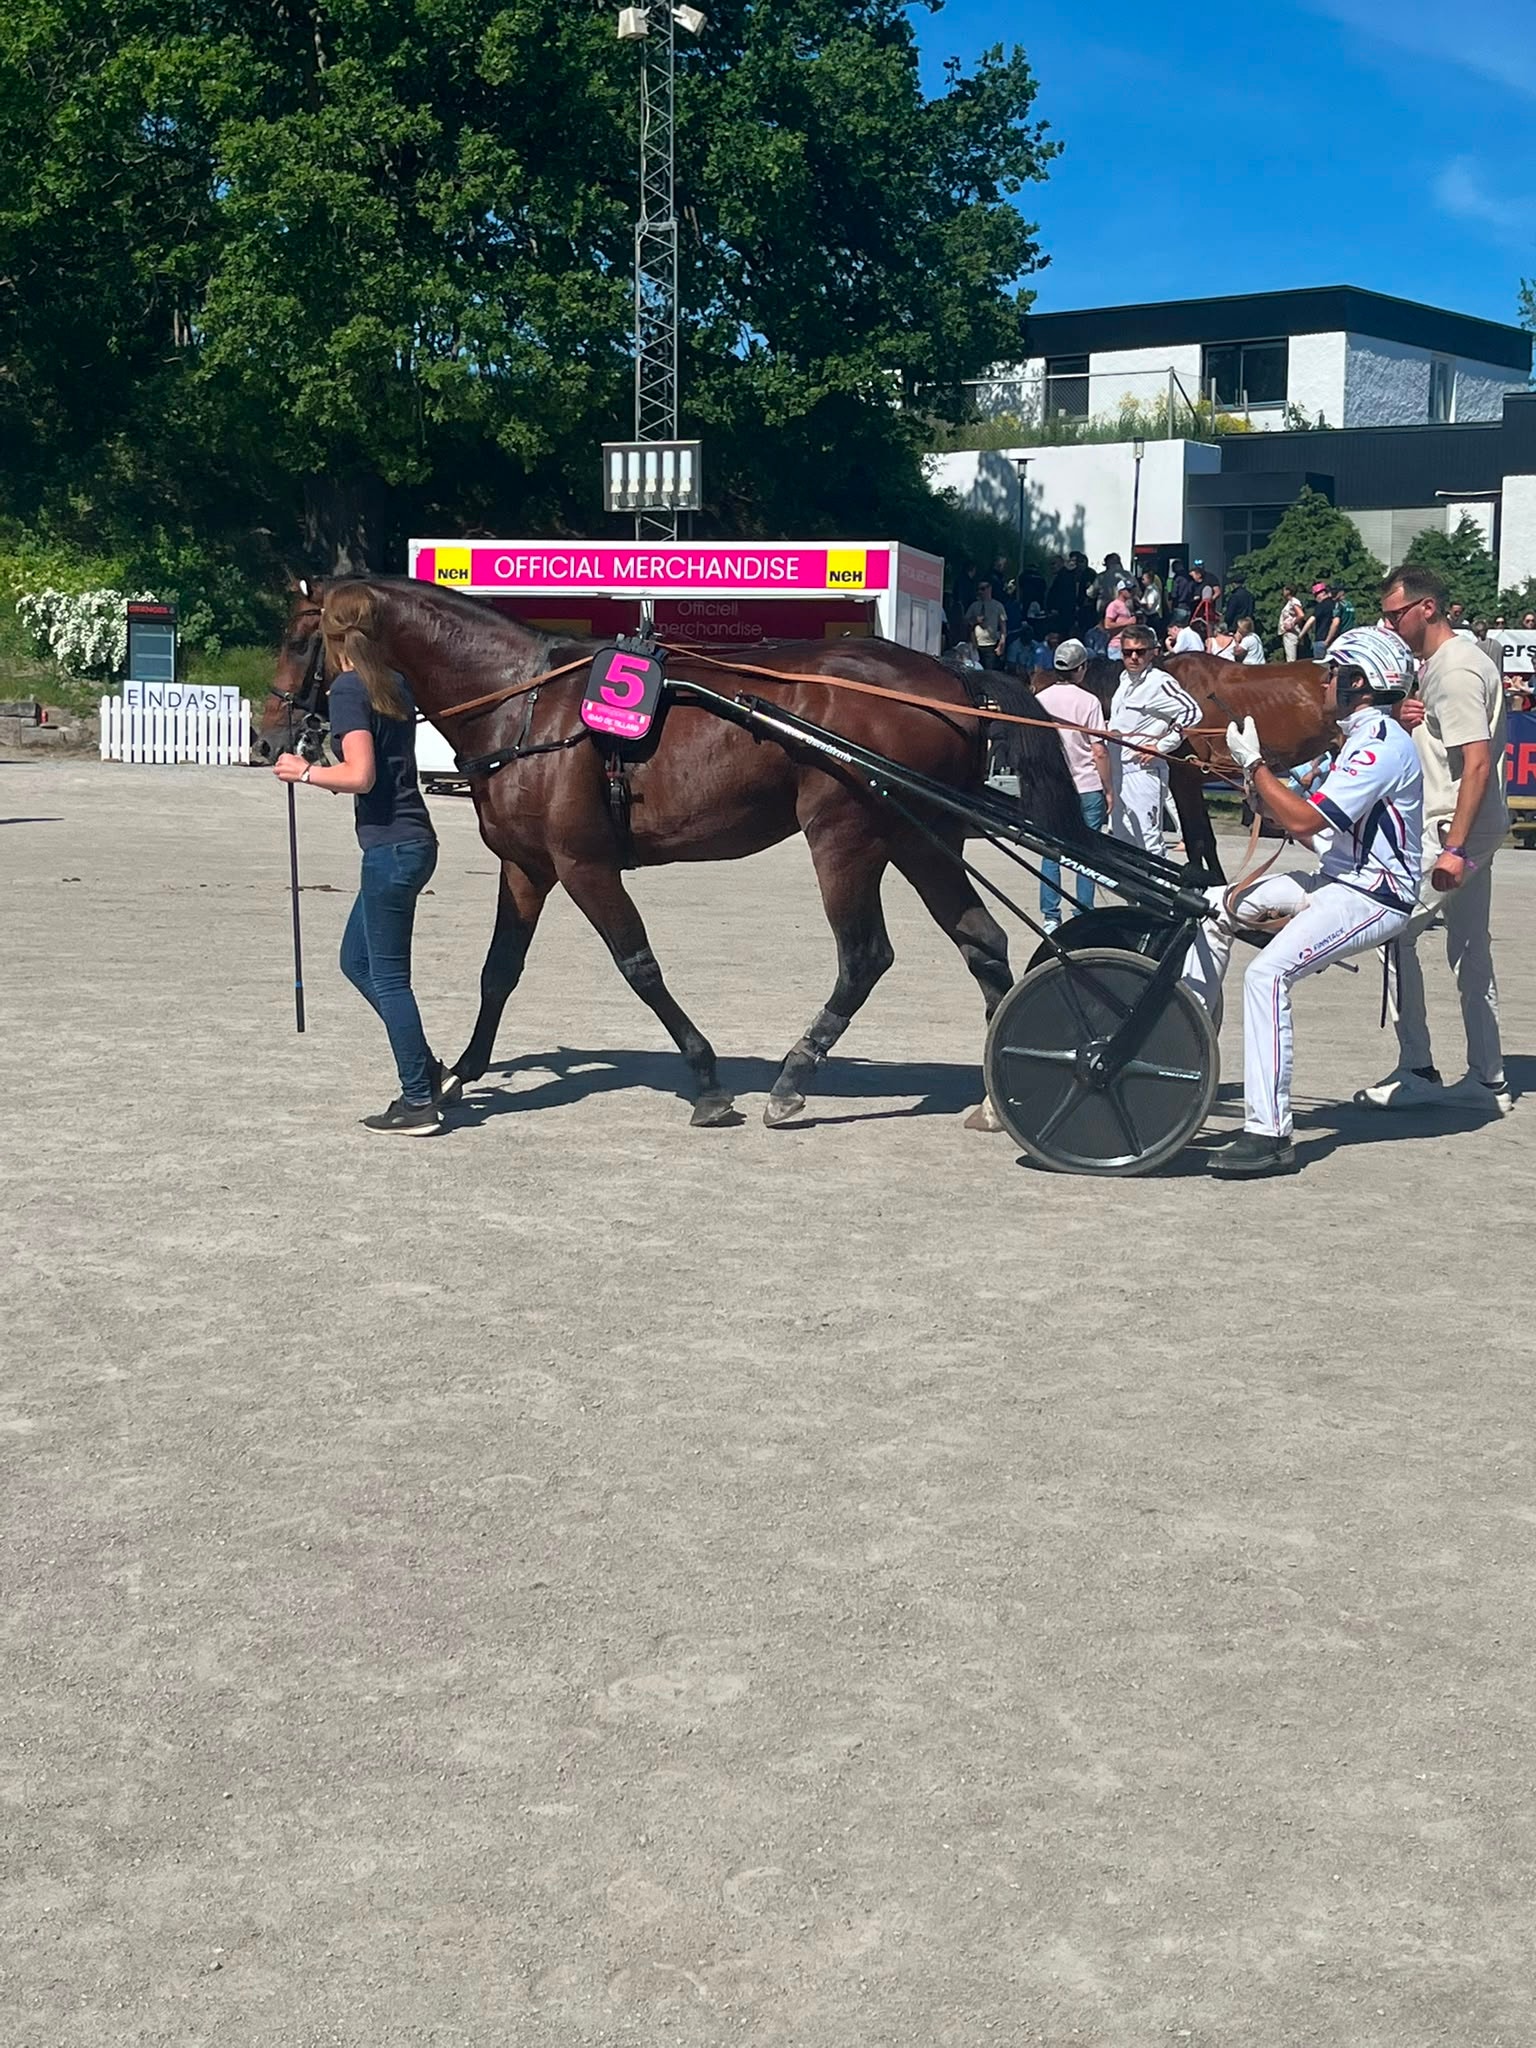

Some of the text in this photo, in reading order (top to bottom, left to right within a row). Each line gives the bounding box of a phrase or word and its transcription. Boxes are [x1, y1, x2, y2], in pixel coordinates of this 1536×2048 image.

[494, 556, 799, 581] OFFICIAL MERCHANDISE
[677, 600, 738, 616] Officiell
[600, 653, 650, 708] 5
[1060, 855, 1119, 889] YANKEE
